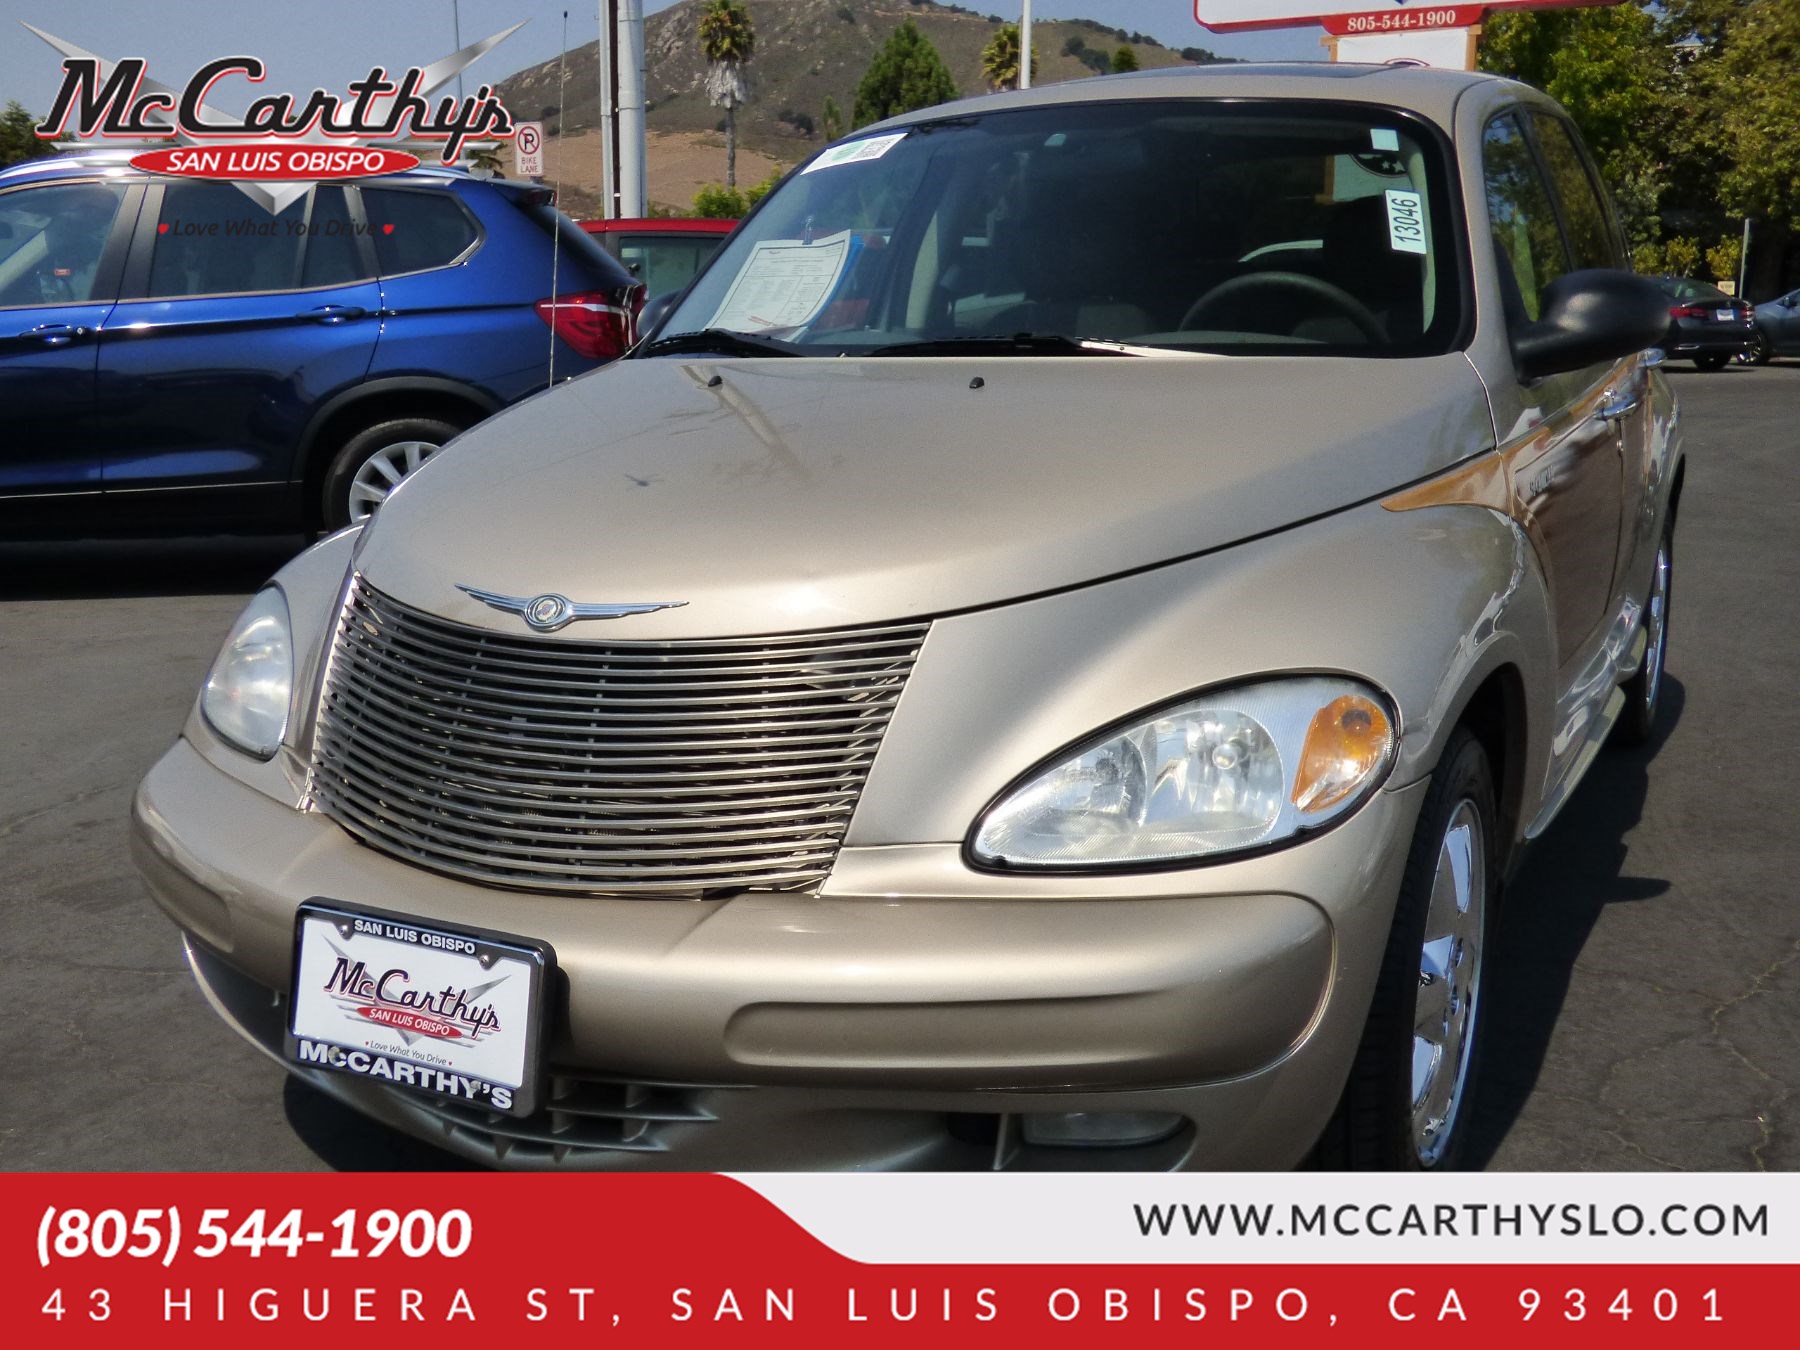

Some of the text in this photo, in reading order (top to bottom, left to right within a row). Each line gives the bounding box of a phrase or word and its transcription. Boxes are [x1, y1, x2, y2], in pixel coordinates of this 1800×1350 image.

[1347, 10, 1456, 31] 805-544-1900
[520, 165, 539, 173] LANE
[521, 156, 537, 165] BIKE
[1391, 198, 1422, 242] 13046
[354, 919, 476, 954] SAN LUIS OBISPO
[324, 957, 501, 1041] McCarthy's
[369, 1008, 450, 1035] SAN LUIS OBISPO
[370, 1040, 447, 1065] Love What You Drive
